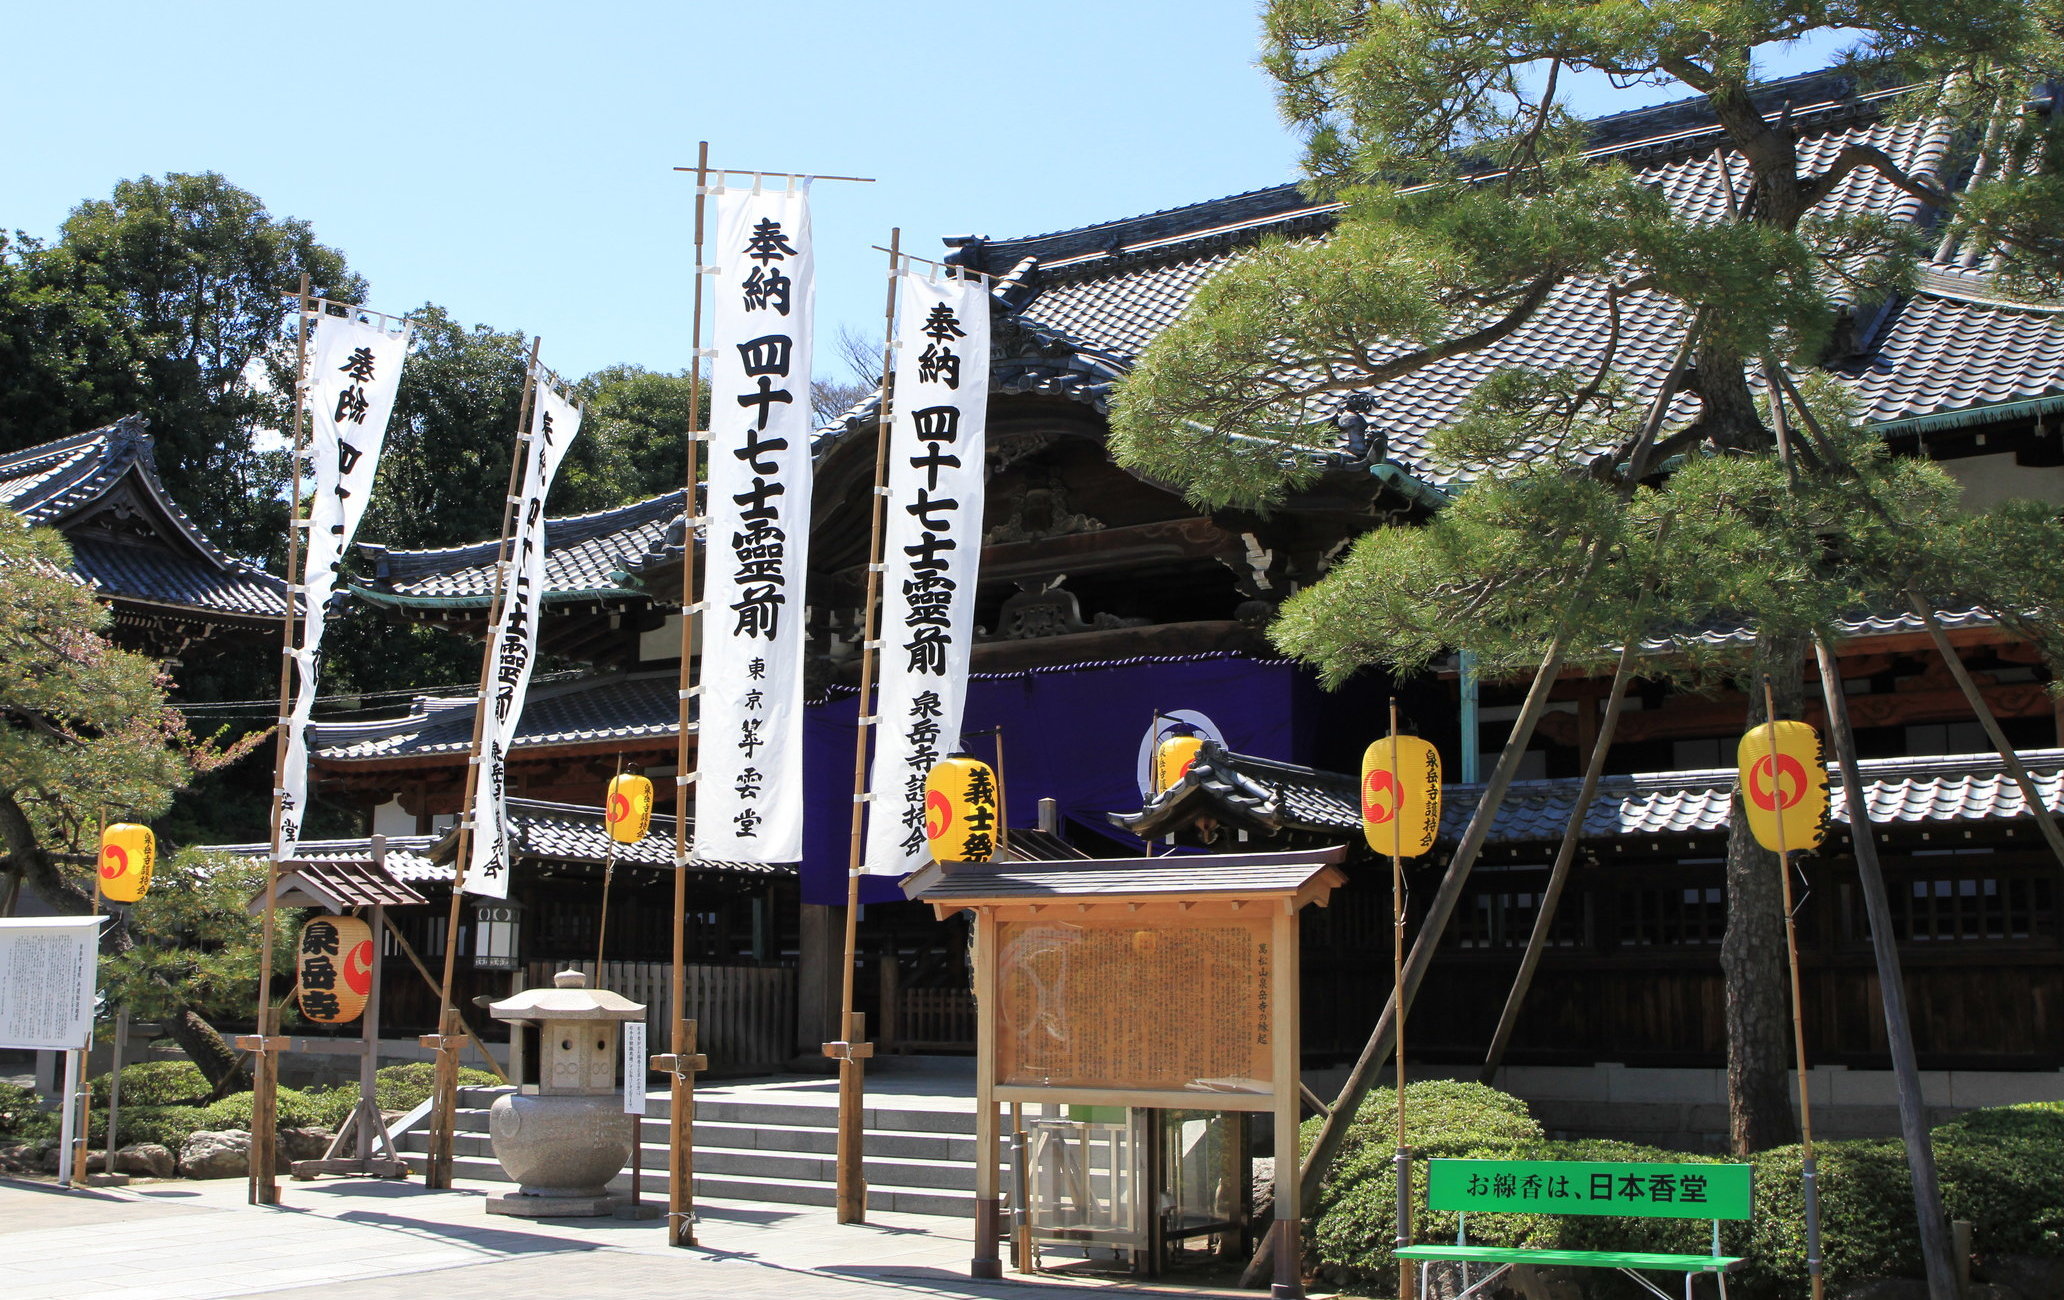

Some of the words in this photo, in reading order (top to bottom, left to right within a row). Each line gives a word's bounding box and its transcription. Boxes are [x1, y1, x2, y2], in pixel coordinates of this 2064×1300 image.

[742, 216, 799, 317] 奉納
[919, 301, 968, 391] 奉納
[302, 921, 341, 1020] 泉岳寺
